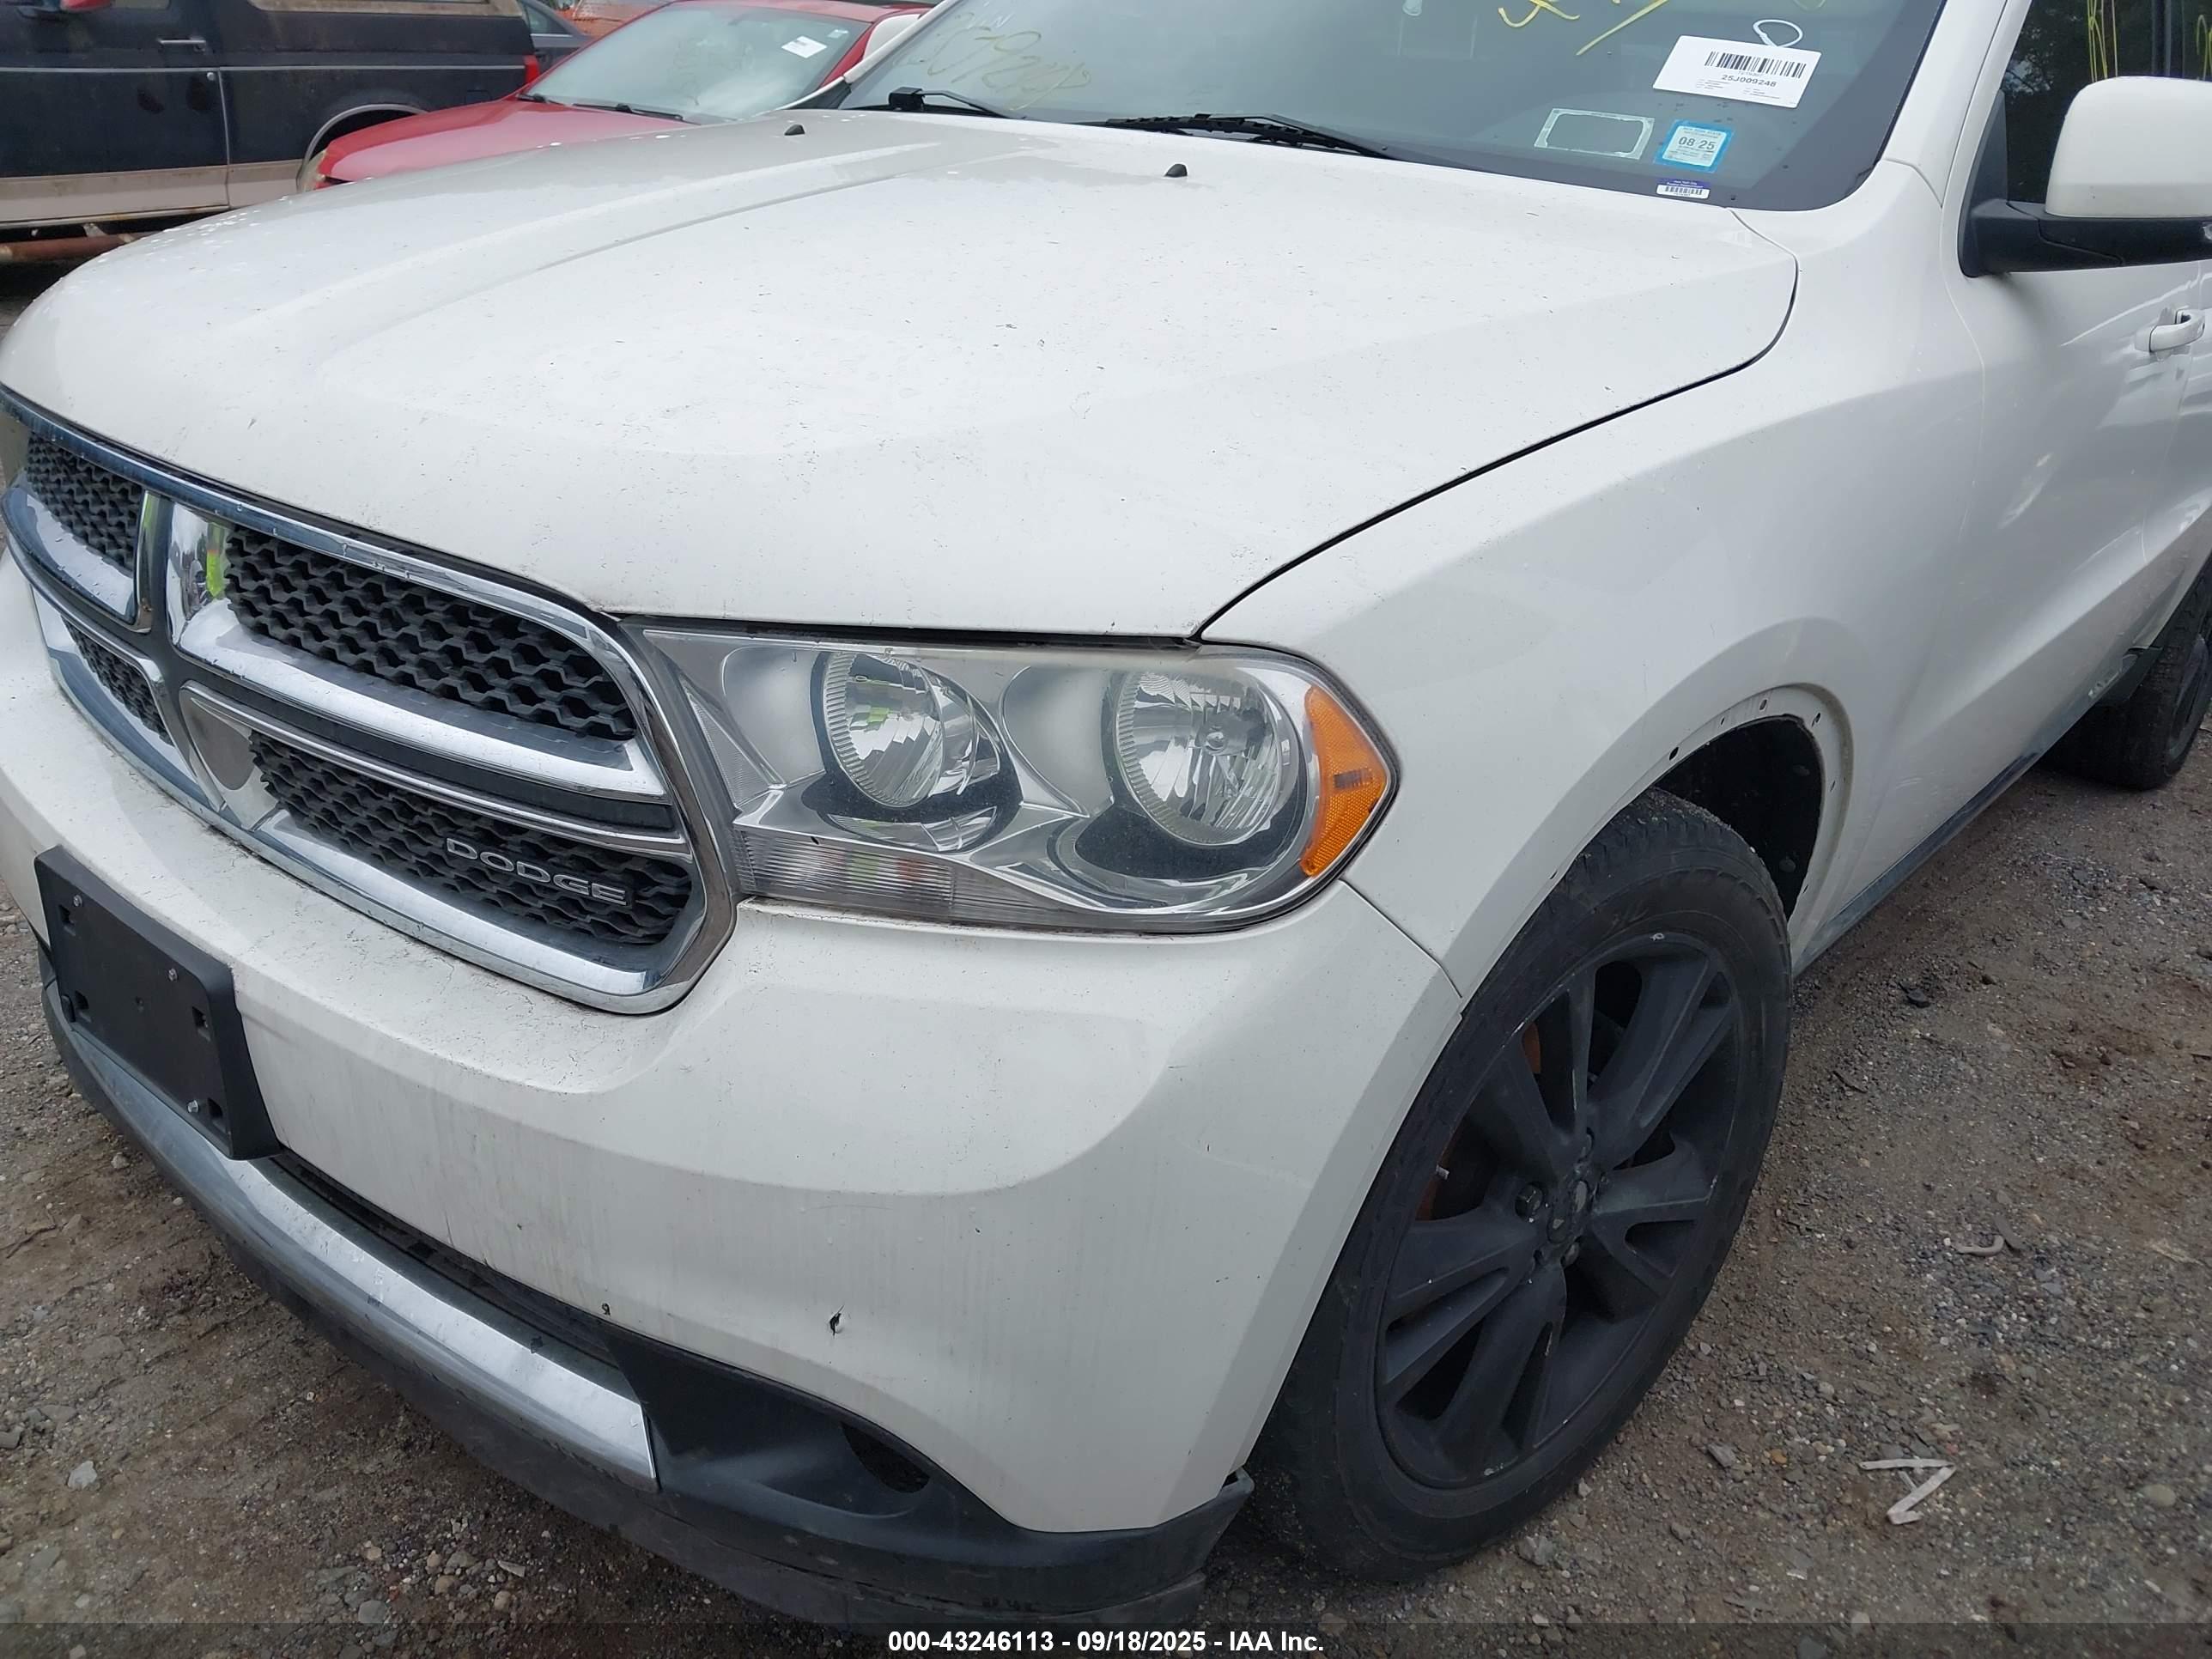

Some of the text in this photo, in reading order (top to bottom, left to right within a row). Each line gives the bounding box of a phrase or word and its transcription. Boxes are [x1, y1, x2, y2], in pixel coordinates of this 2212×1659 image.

[1721, 74, 1778, 88] 25J009248
[1678, 137, 1717, 150] 08 25
[446, 837, 628, 906] DODGE
